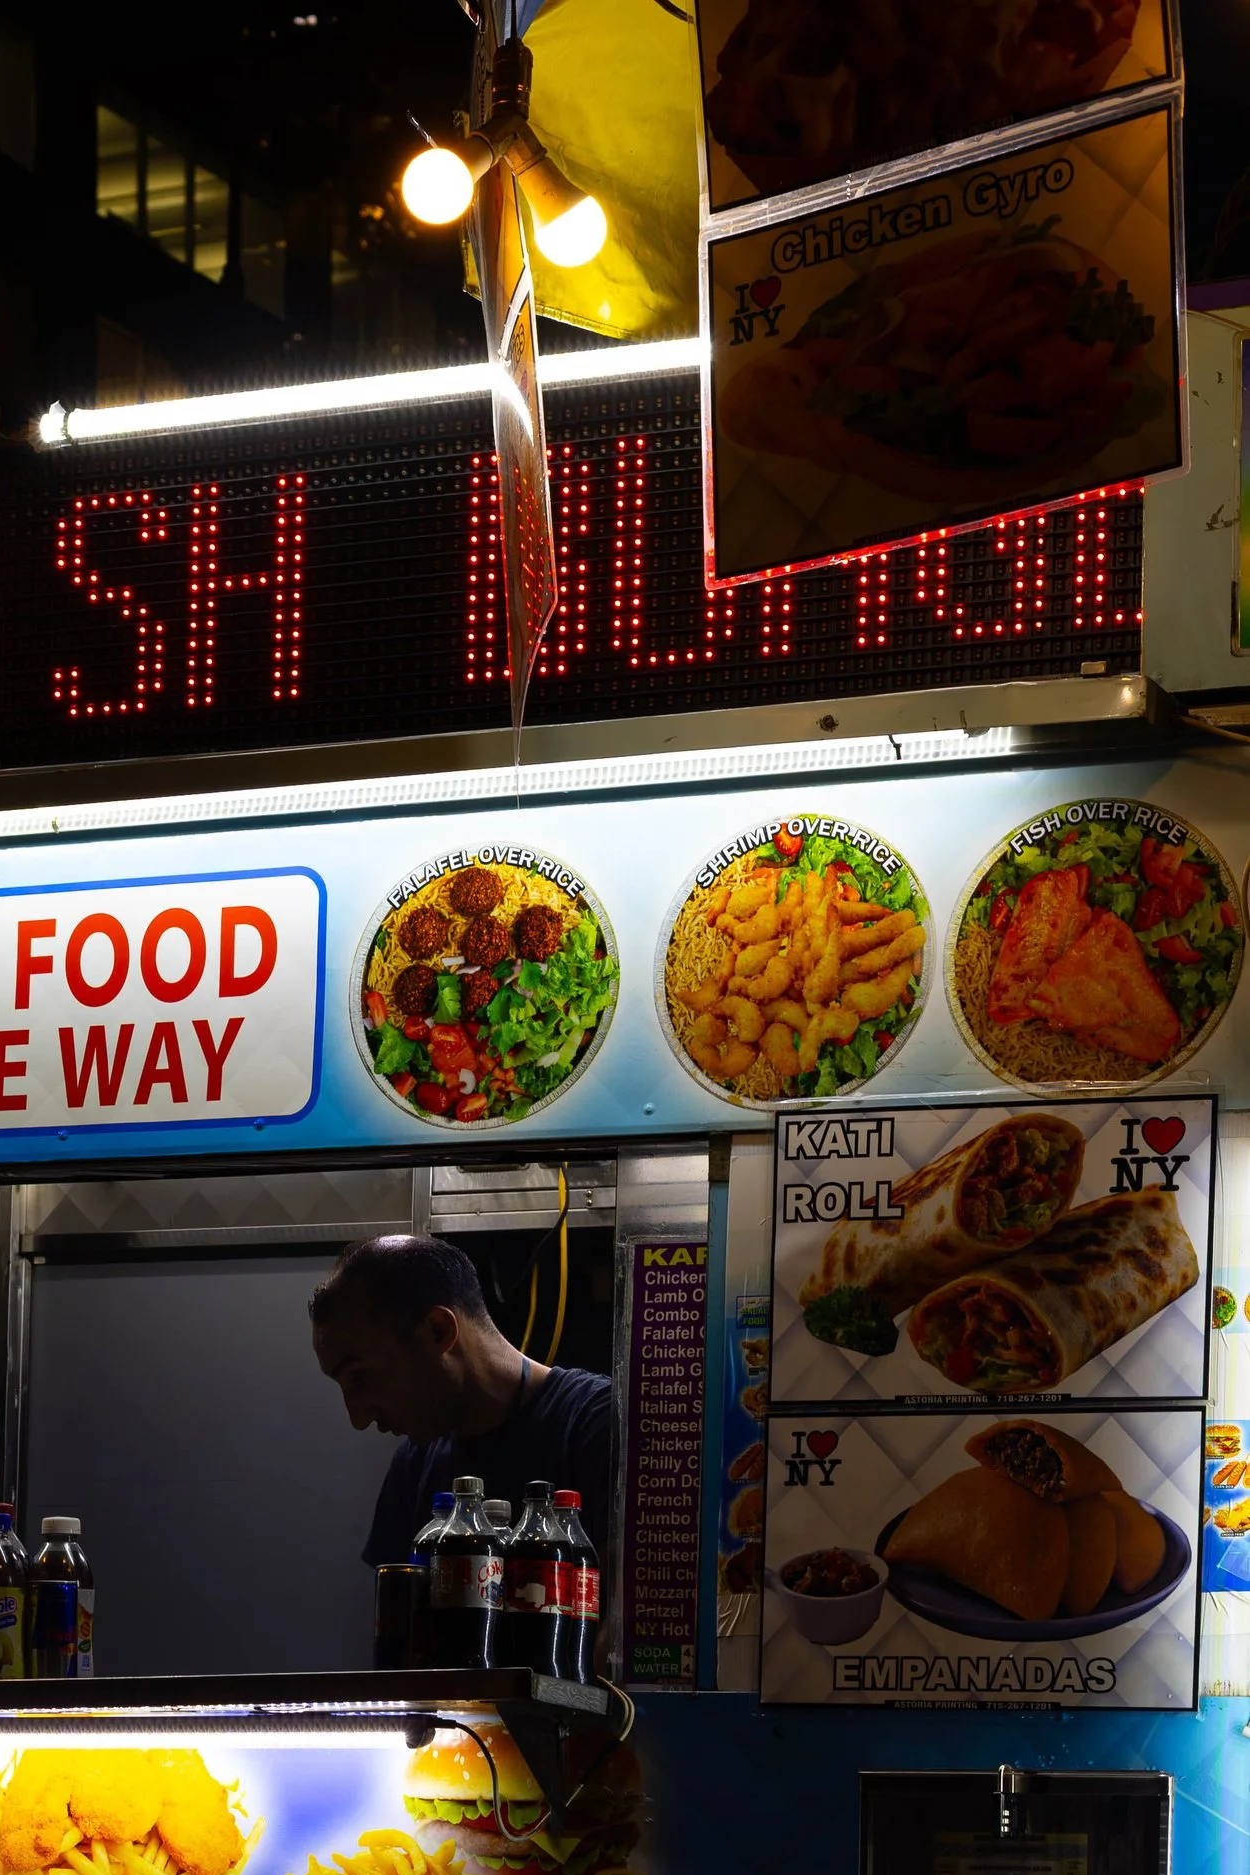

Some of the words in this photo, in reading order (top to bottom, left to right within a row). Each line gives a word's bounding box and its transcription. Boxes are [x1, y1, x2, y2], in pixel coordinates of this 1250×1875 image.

[772, 193, 951, 274] Chicken
[964, 158, 1074, 220] Gyro
[729, 304, 786, 345] NY
[1009, 812, 1062, 855] FISH
[1066, 802, 1129, 824] OVER
[1134, 806, 1187, 845] RICE
[696, 821, 782, 889] SHRIMP
[787, 817, 850, 842] OVER
[851, 829, 903, 876] RICE
[388, 850, 474, 910] FALAFEL
[478, 846, 535, 868] OVER
[537, 857, 585, 898] RICE
[14, 905, 278, 1010] FOOD
[58, 1016, 245, 1108] WAY
[784, 1116, 895, 1160] KATI
[1110, 1155, 1190, 1192] NY
[783, 1181, 903, 1223] ROLL
[644, 1289, 687, 1304] Lamb
[643, 1307, 699, 1322] Combo
[643, 1326, 694, 1341] Falafel
[641, 1363, 684, 1377] Lamb
[640, 1382, 692, 1396] Falafel
[640, 1400, 687, 1414] Italian
[638, 1456, 682, 1473] Philly
[638, 1474, 677, 1488] Corn
[785, 1460, 842, 1487] NY
[637, 1493, 692, 1507] French
[636, 1511, 691, 1526] Jumbo
[635, 1567, 670, 1581] Chili
[635, 1623, 658, 1636] NY
[662, 1623, 690, 1637] Hot
[633, 1648, 671, 1658] SODA
[634, 1663, 679, 1674] WATER
[833, 1655, 1117, 1694] EMPANADAS
